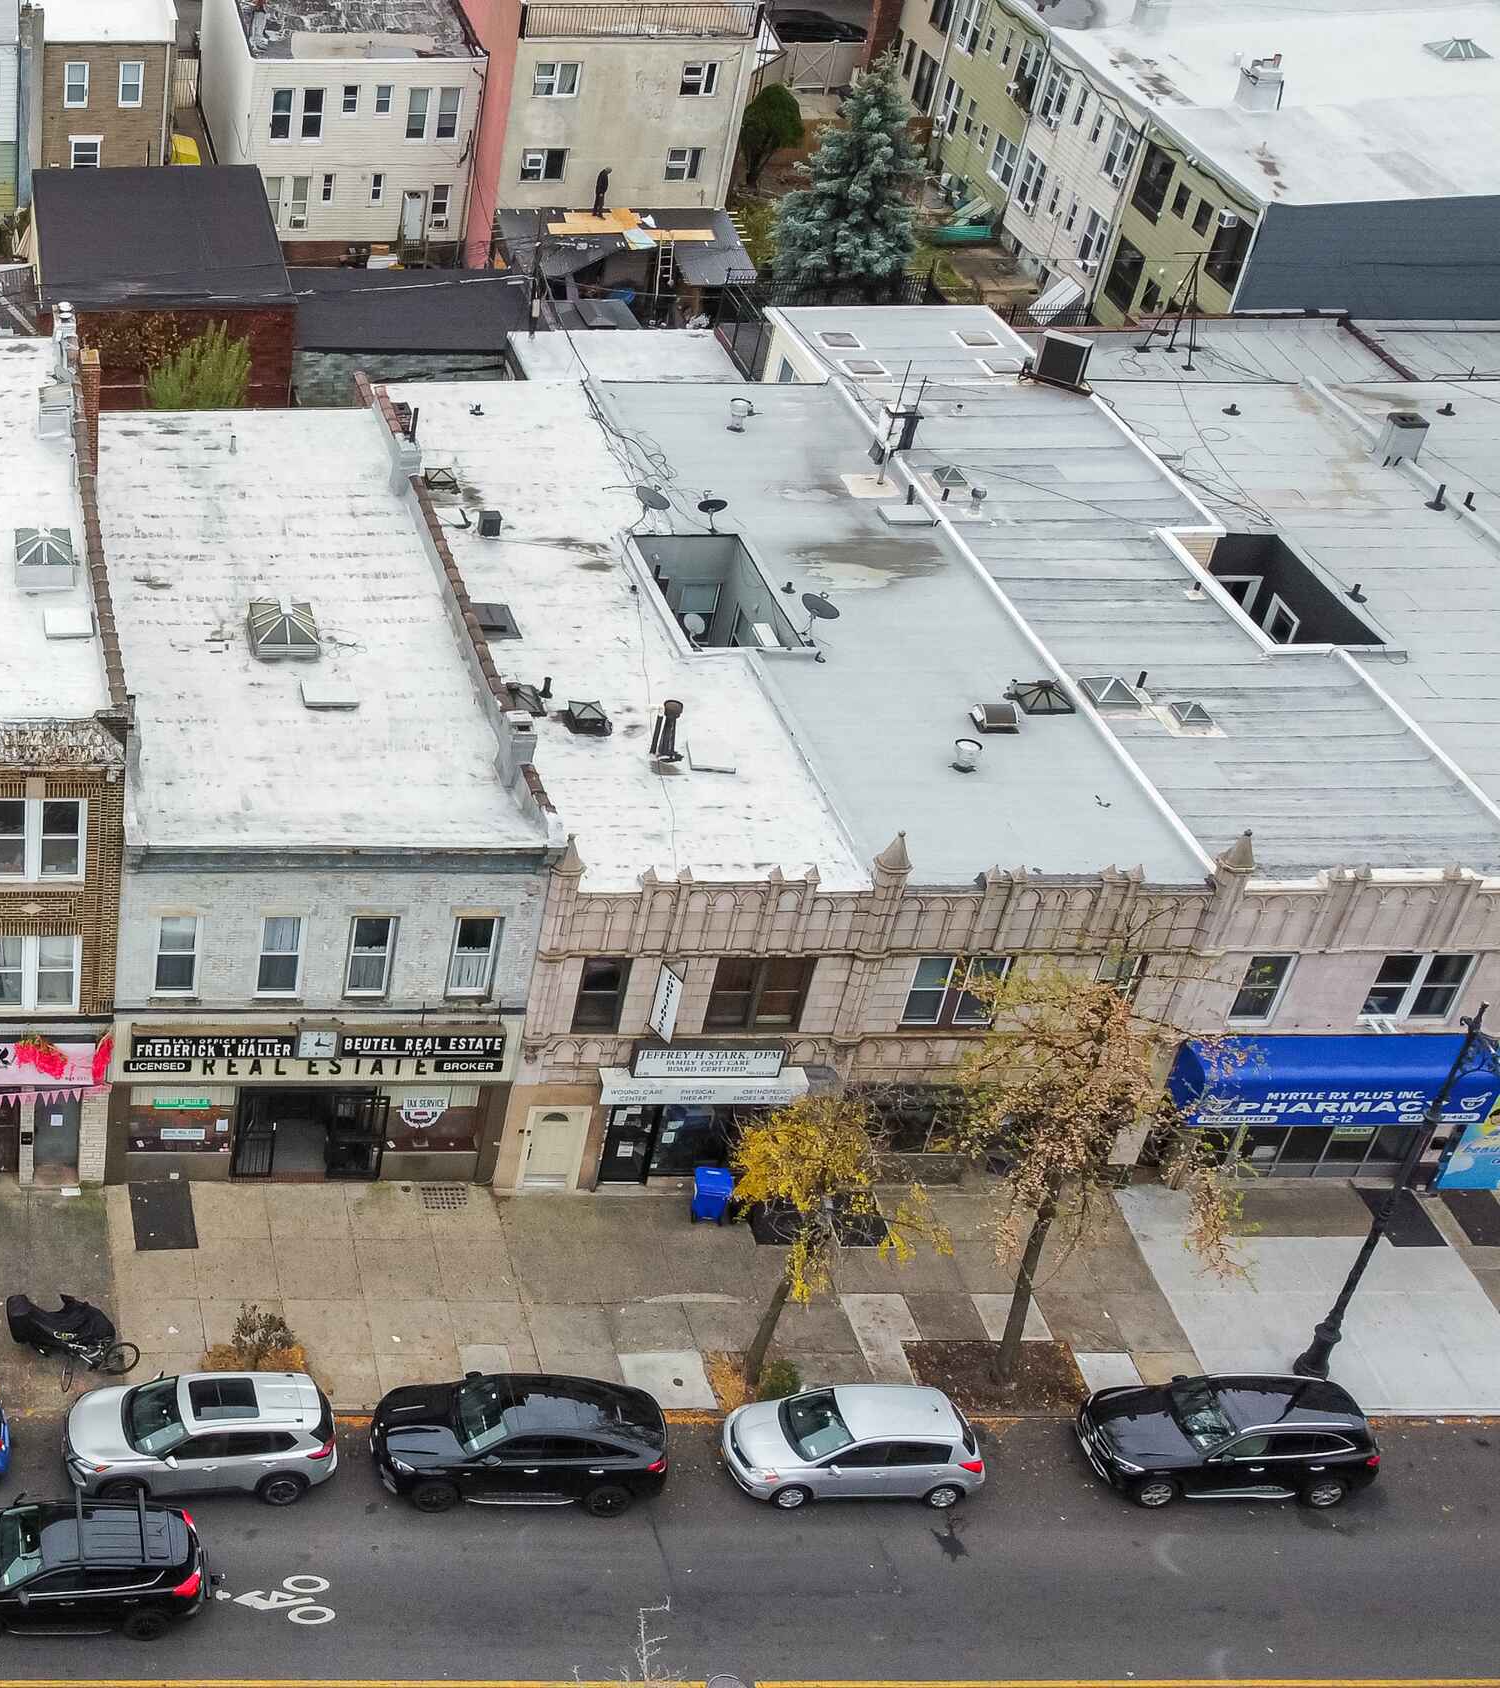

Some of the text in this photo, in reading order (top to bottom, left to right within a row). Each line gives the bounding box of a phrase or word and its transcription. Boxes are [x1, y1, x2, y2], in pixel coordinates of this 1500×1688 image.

[344, 1037, 503, 1050] BEUTEL REAL ESTATE
[136, 1044, 292, 1057] FREDERICK T. HALLER
[639, 1051, 691, 1061] JEFFREY
[695, 1051, 705, 1060] H
[129, 1062, 186, 1071] LICENSED
[202, 1059, 287, 1075] REAL
[443, 1062, 495, 1071] BROKER
[1266, 1091, 1326, 1100] MYRTLE
[1329, 1091, 1349, 1100] RX
[1353, 1091, 1394, 1100] PLUS
